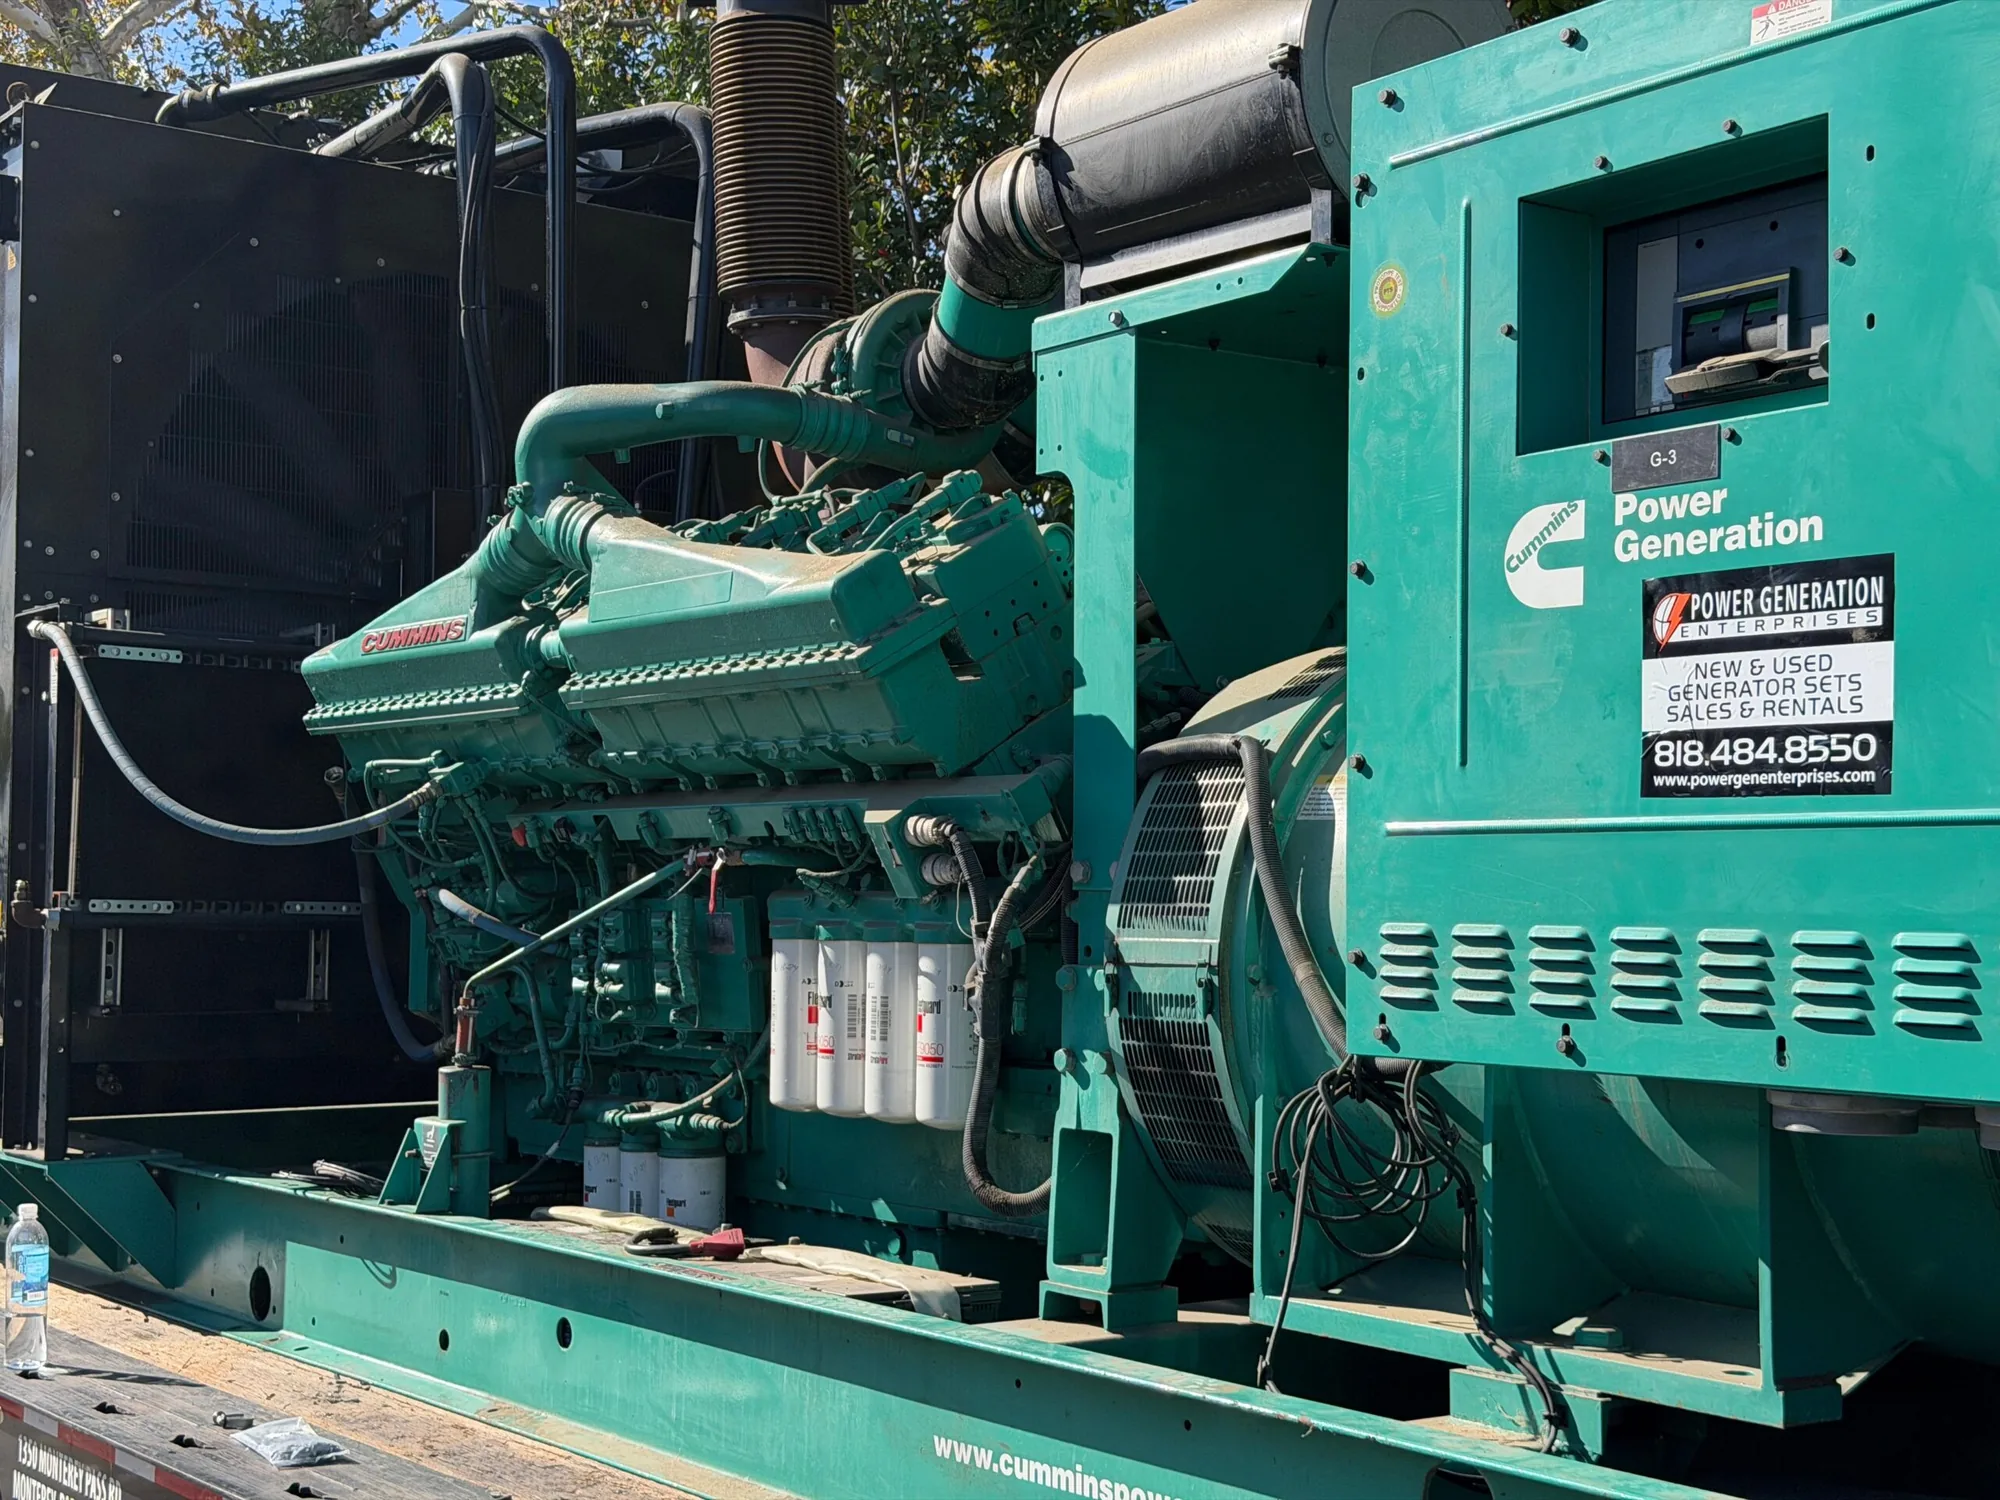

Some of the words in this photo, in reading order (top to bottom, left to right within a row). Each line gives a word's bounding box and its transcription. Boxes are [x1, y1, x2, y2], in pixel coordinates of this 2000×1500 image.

[1650, 449, 1677, 467] G-3
[1614, 487, 1728, 526] Power
[1505, 500, 1579, 574] Cummins
[1614, 511, 1823, 563] Generation
[1690, 588, 1753, 620] POWER
[1760, 576, 1884, 614] GENERATION
[361, 619, 465, 653] CUMMINS
[1680, 609, 1878, 638] ENTERPRISES
[1695, 660, 1742, 680] NEW
[1750, 658, 1765, 676] &
[1773, 654, 1833, 674] USED
[1668, 678, 1795, 702] GENERATOR
[1804, 673, 1862, 694] SETS
[1667, 702, 1732, 723] SALES
[1740, 701, 1755, 718] &
[1763, 695, 1864, 717] RENTALS
[1653, 733, 1877, 768] 818.484.8550
[1653, 768, 1876, 790] www.powergenenterprises.com
[18, 1433, 38, 1470] 1350
[38, 1443, 84, 1494] MONTEREY
[85, 1464, 107, 1500] PASS
[108, 1476, 122, 1500] RD
